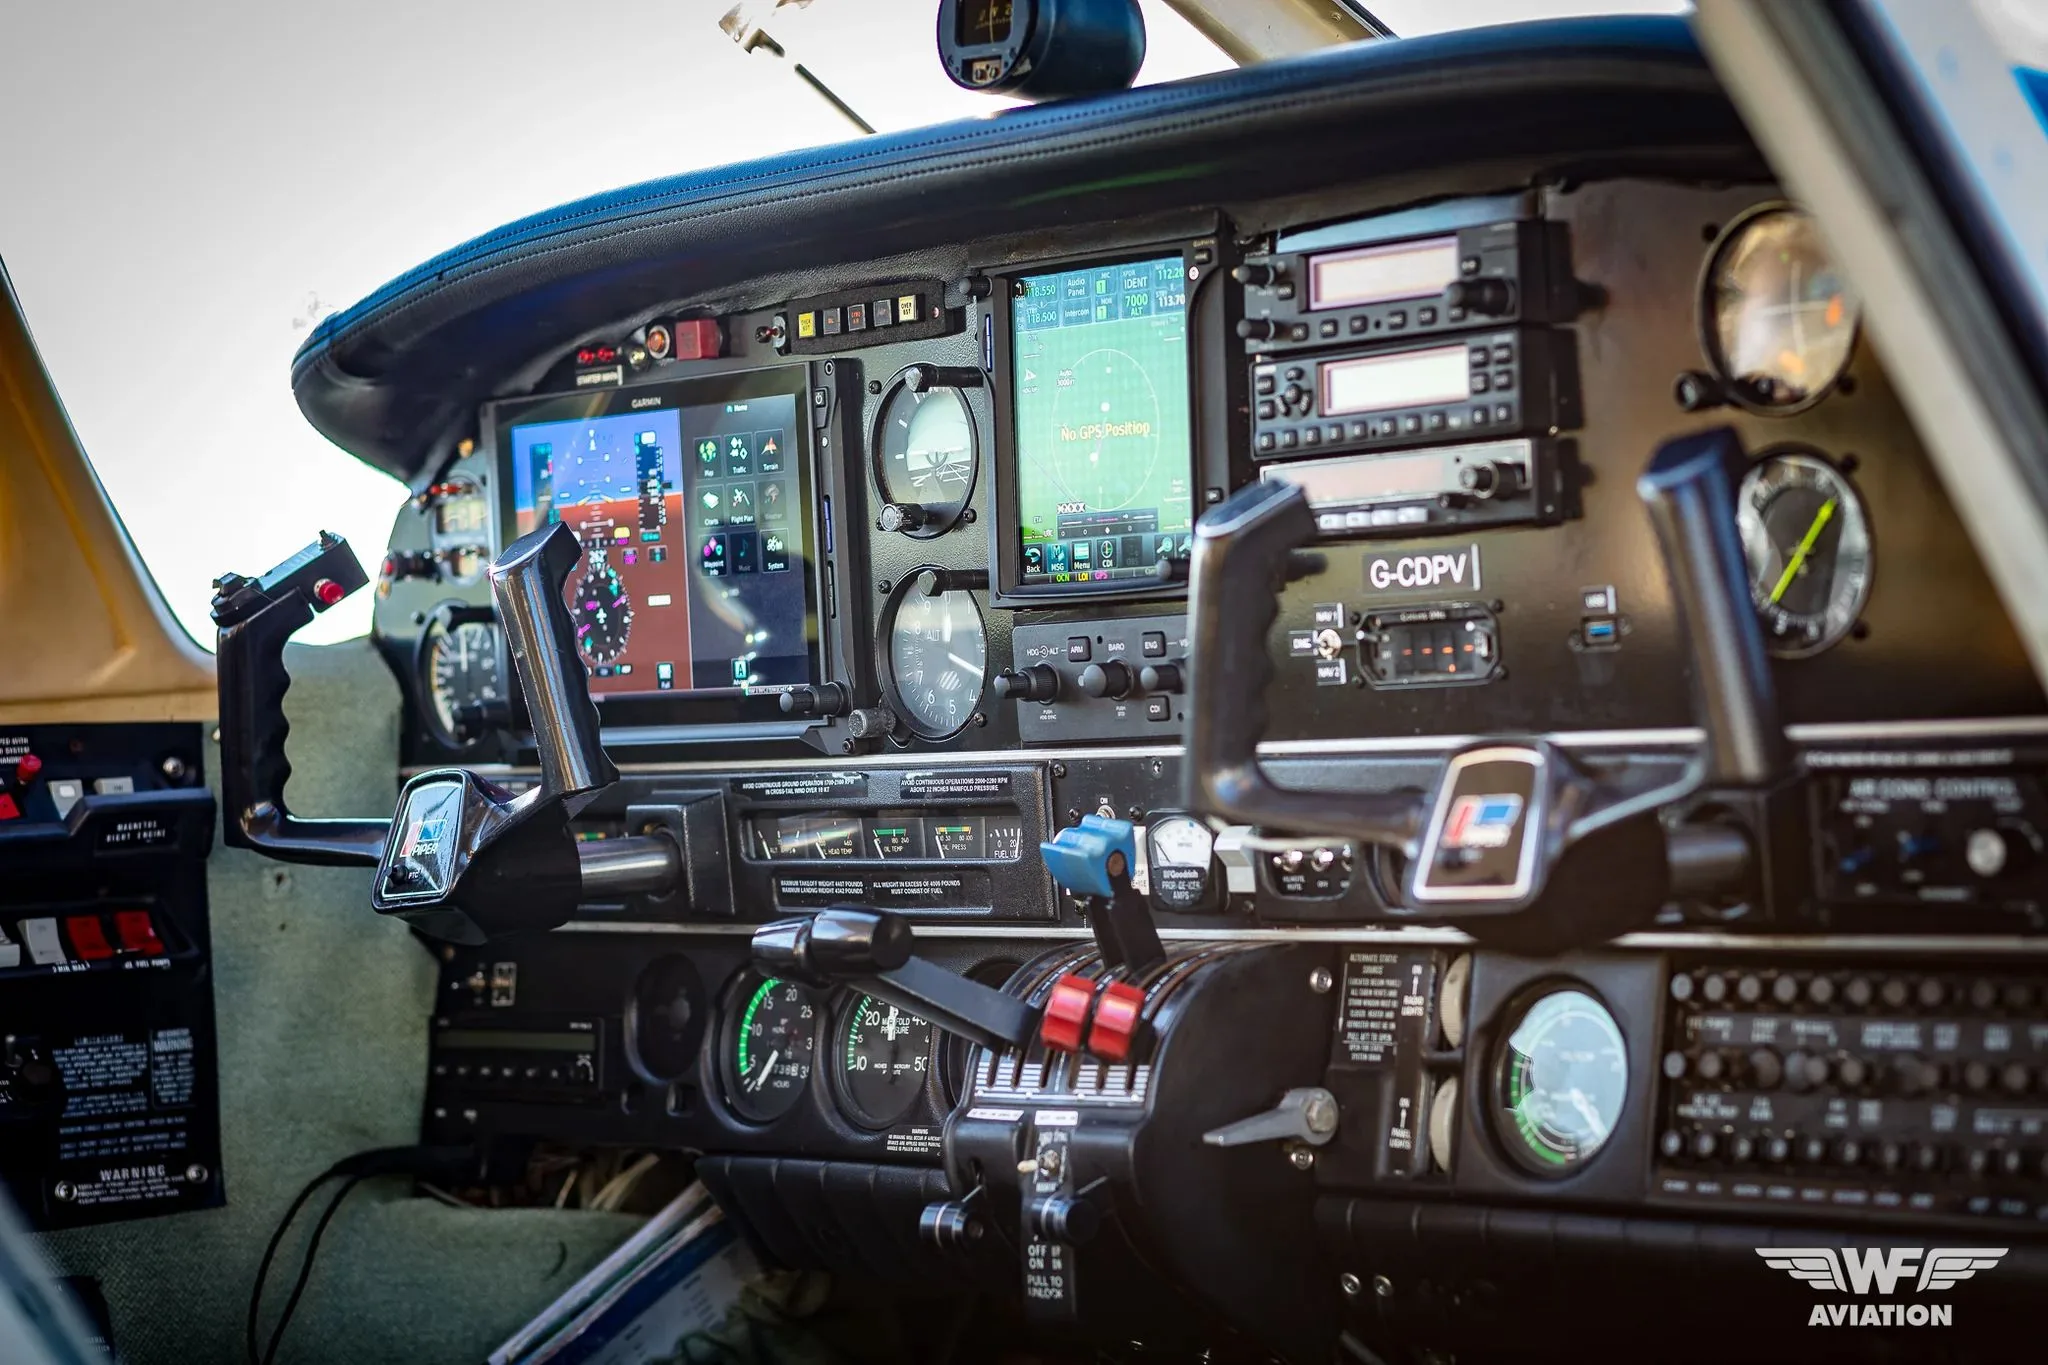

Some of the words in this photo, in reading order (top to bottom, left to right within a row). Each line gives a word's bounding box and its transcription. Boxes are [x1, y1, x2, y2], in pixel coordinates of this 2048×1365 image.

[1158, 267, 1184, 281] 112.20
[1067, 278, 1086, 287] Audio
[1124, 277, 1148, 289] IDENT
[1026, 285, 1056, 297] 118.550
[1067, 286, 1086, 296] Panel
[1125, 294, 1148, 307] 7000
[1158, 293, 1186, 307] 113.70
[1026, 311, 1057, 324] 118.500
[1064, 307, 1089, 318] Intercom
[1130, 307, 1144, 317] ALT
[631, 397, 661, 408] GARMIN
[1061, 428, 1077, 442] No
[1079, 424, 1101, 440] GPS
[1104, 420, 1151, 437] Position
[732, 465, 747, 474] Traffic
[763, 463, 779, 471] Terrain
[731, 516, 744, 524] Flight
[704, 560, 724, 569] Waypoint
[767, 561, 784, 570] System
[1026, 564, 1041, 573] Back
[1051, 563, 1064, 571] MSG
[1074, 561, 1090, 571] Menu
[1102, 559, 1113, 568] CDI
[1095, 570, 1108, 580] GPS
[1370, 553, 1467, 589] G-CDPV
[1056, 572, 1070, 582] OCN
[1078, 572, 1089, 582] LOI
[924, 601, 932, 613] 9
[967, 599, 971, 615] 1
[914, 621, 921, 634] 8
[978, 624, 984, 637] 2
[927, 629, 941, 642] ALT
[1070, 646, 1084, 654] ARM
[1108, 643, 1125, 651] BARO
[1144, 641, 1158, 649] ENG
[1027, 649, 1040, 657] HDG
[1049, 647, 1059, 655] ALT
[916, 670, 924, 685] 7
[927, 690, 936, 704] 6
[969, 689, 977, 704] 4
[949, 700, 957, 715] 5
[755, 781, 781, 789] CONTINUOUS
[782, 780, 799, 788] GROUND
[951, 843, 967, 851] PRESS
[996, 839, 1001, 848] 0
[1009, 839, 1017, 848] 20
[412, 843, 438, 857] PIPER
[994, 850, 1009, 859] FUEL
[1163, 870, 1199, 879] BFGoodrich
[941, 879, 961, 887] POUNDS
[1173, 891, 1189, 900] AMPS
[1411, 964, 1423, 975] ON
[786, 988, 798, 1002] 20
[763, 997, 774, 1010] 15
[800, 1006, 813, 1019] 25
[865, 1011, 880, 1026] 20
[751, 1023, 762, 1037] 10
[856, 1055, 867, 1071] 10
[914, 1056, 928, 1072] 50
[1391, 1127, 1411, 1139] PANEL
[100, 1164, 166, 1181] WARNING
[1028, 1245, 1048, 1257] OFF
[1028, 1258, 1045, 1269] ON
[1027, 1274, 1049, 1286] PULL
[1049, 1275, 1063, 1288] TO
[1027, 1286, 1064, 1299] UNLOCK
